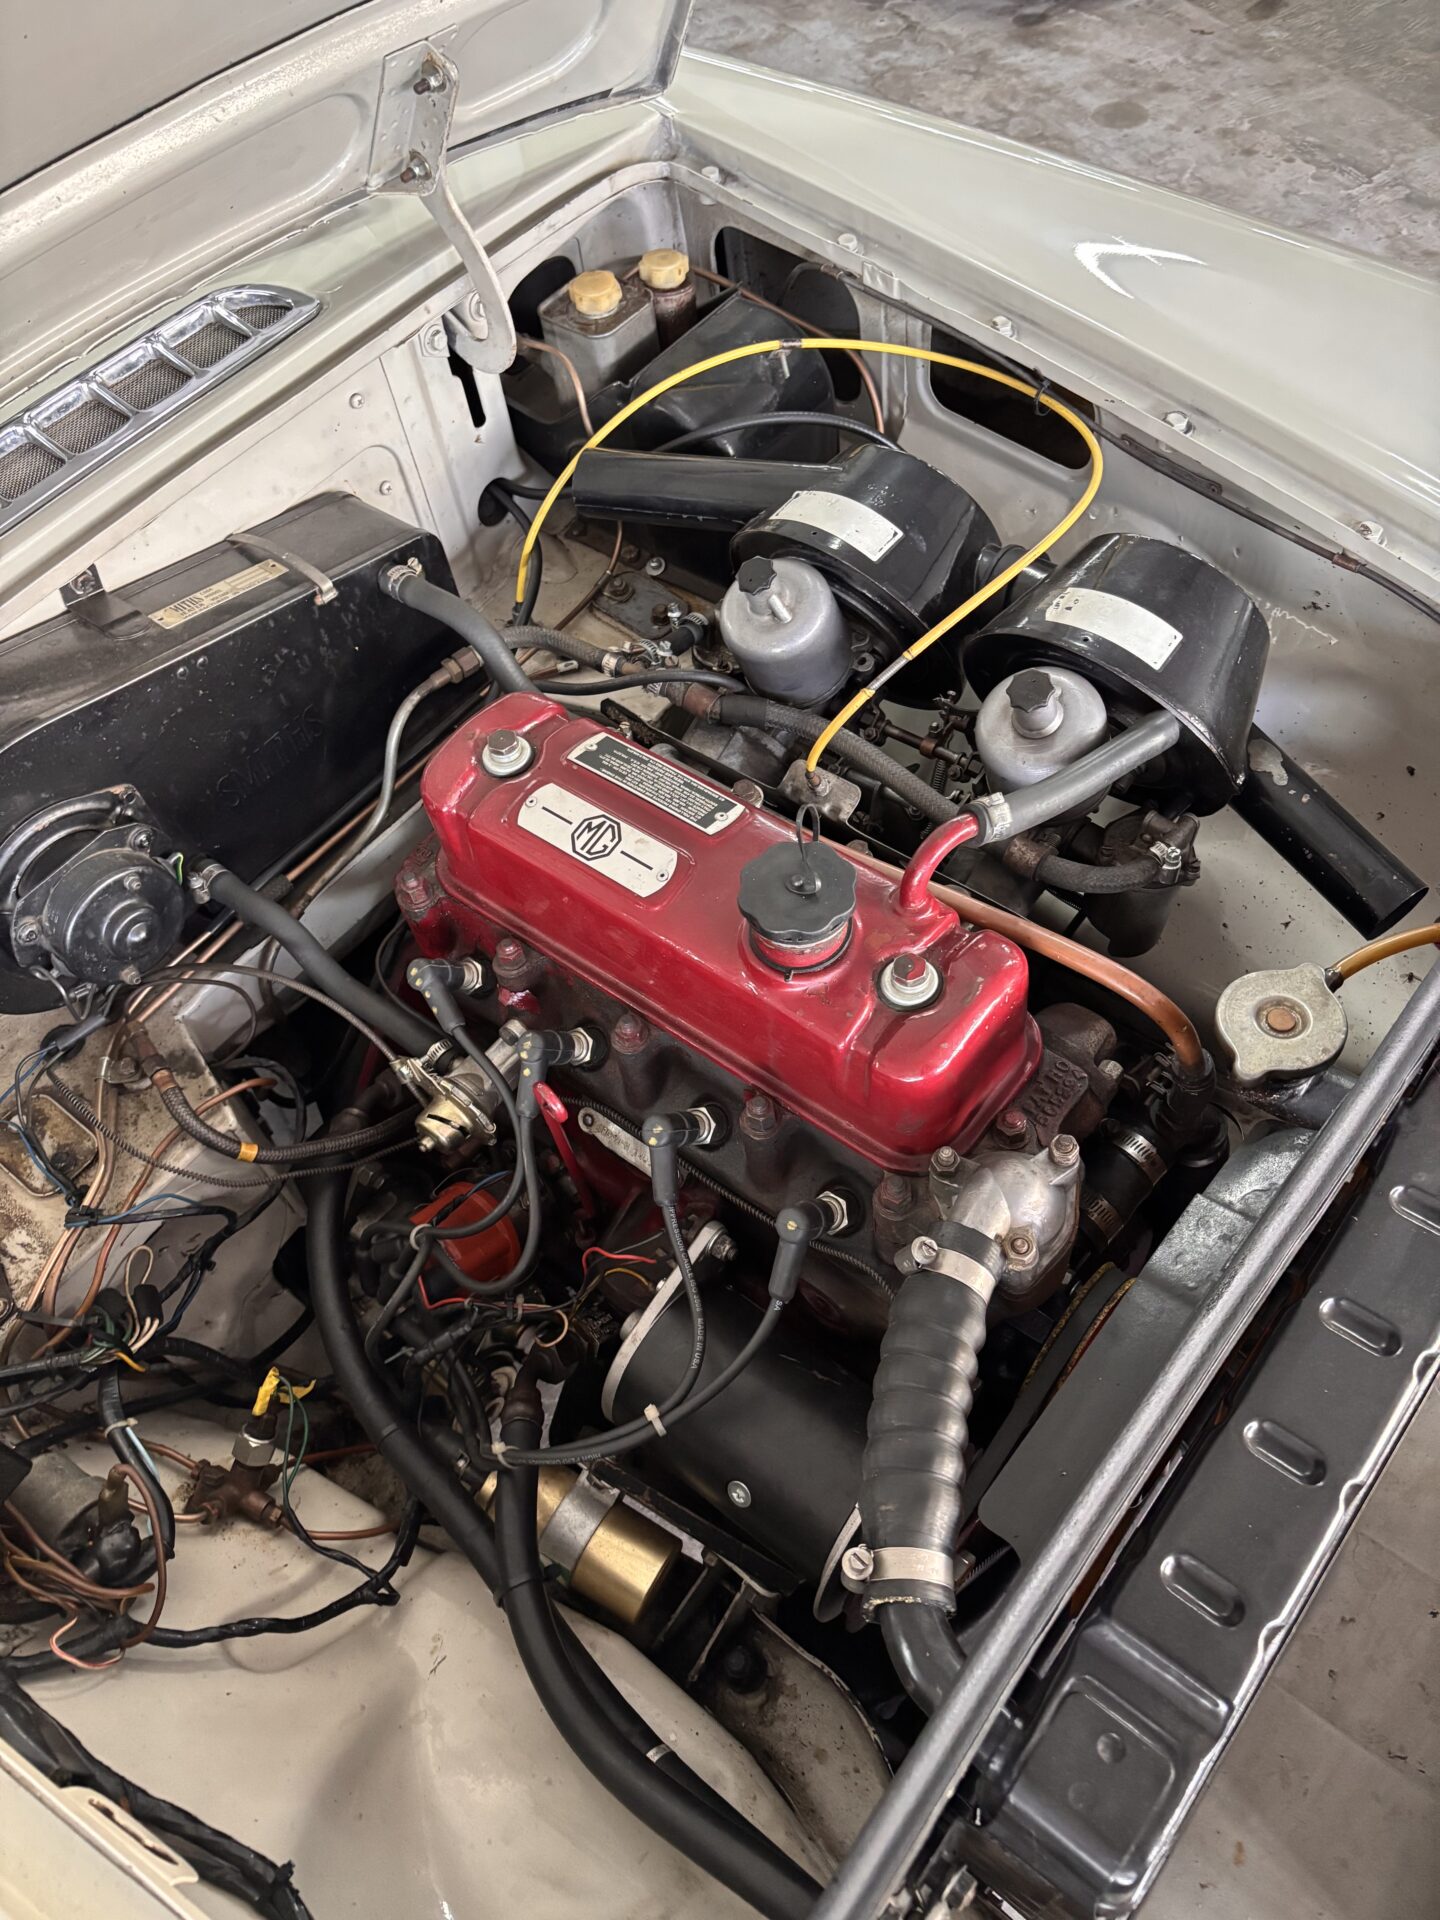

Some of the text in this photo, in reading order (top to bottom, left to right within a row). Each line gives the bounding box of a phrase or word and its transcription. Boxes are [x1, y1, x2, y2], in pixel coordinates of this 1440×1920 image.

[168, 594, 205, 614] MITHS
[576, 818, 617, 855] MG
[668, 1206, 684, 1252] PPRESSION
[680, 1252, 693, 1278] CABLE
[697, 1318, 705, 1341] MADE
[690, 1352, 702, 1369] USA
